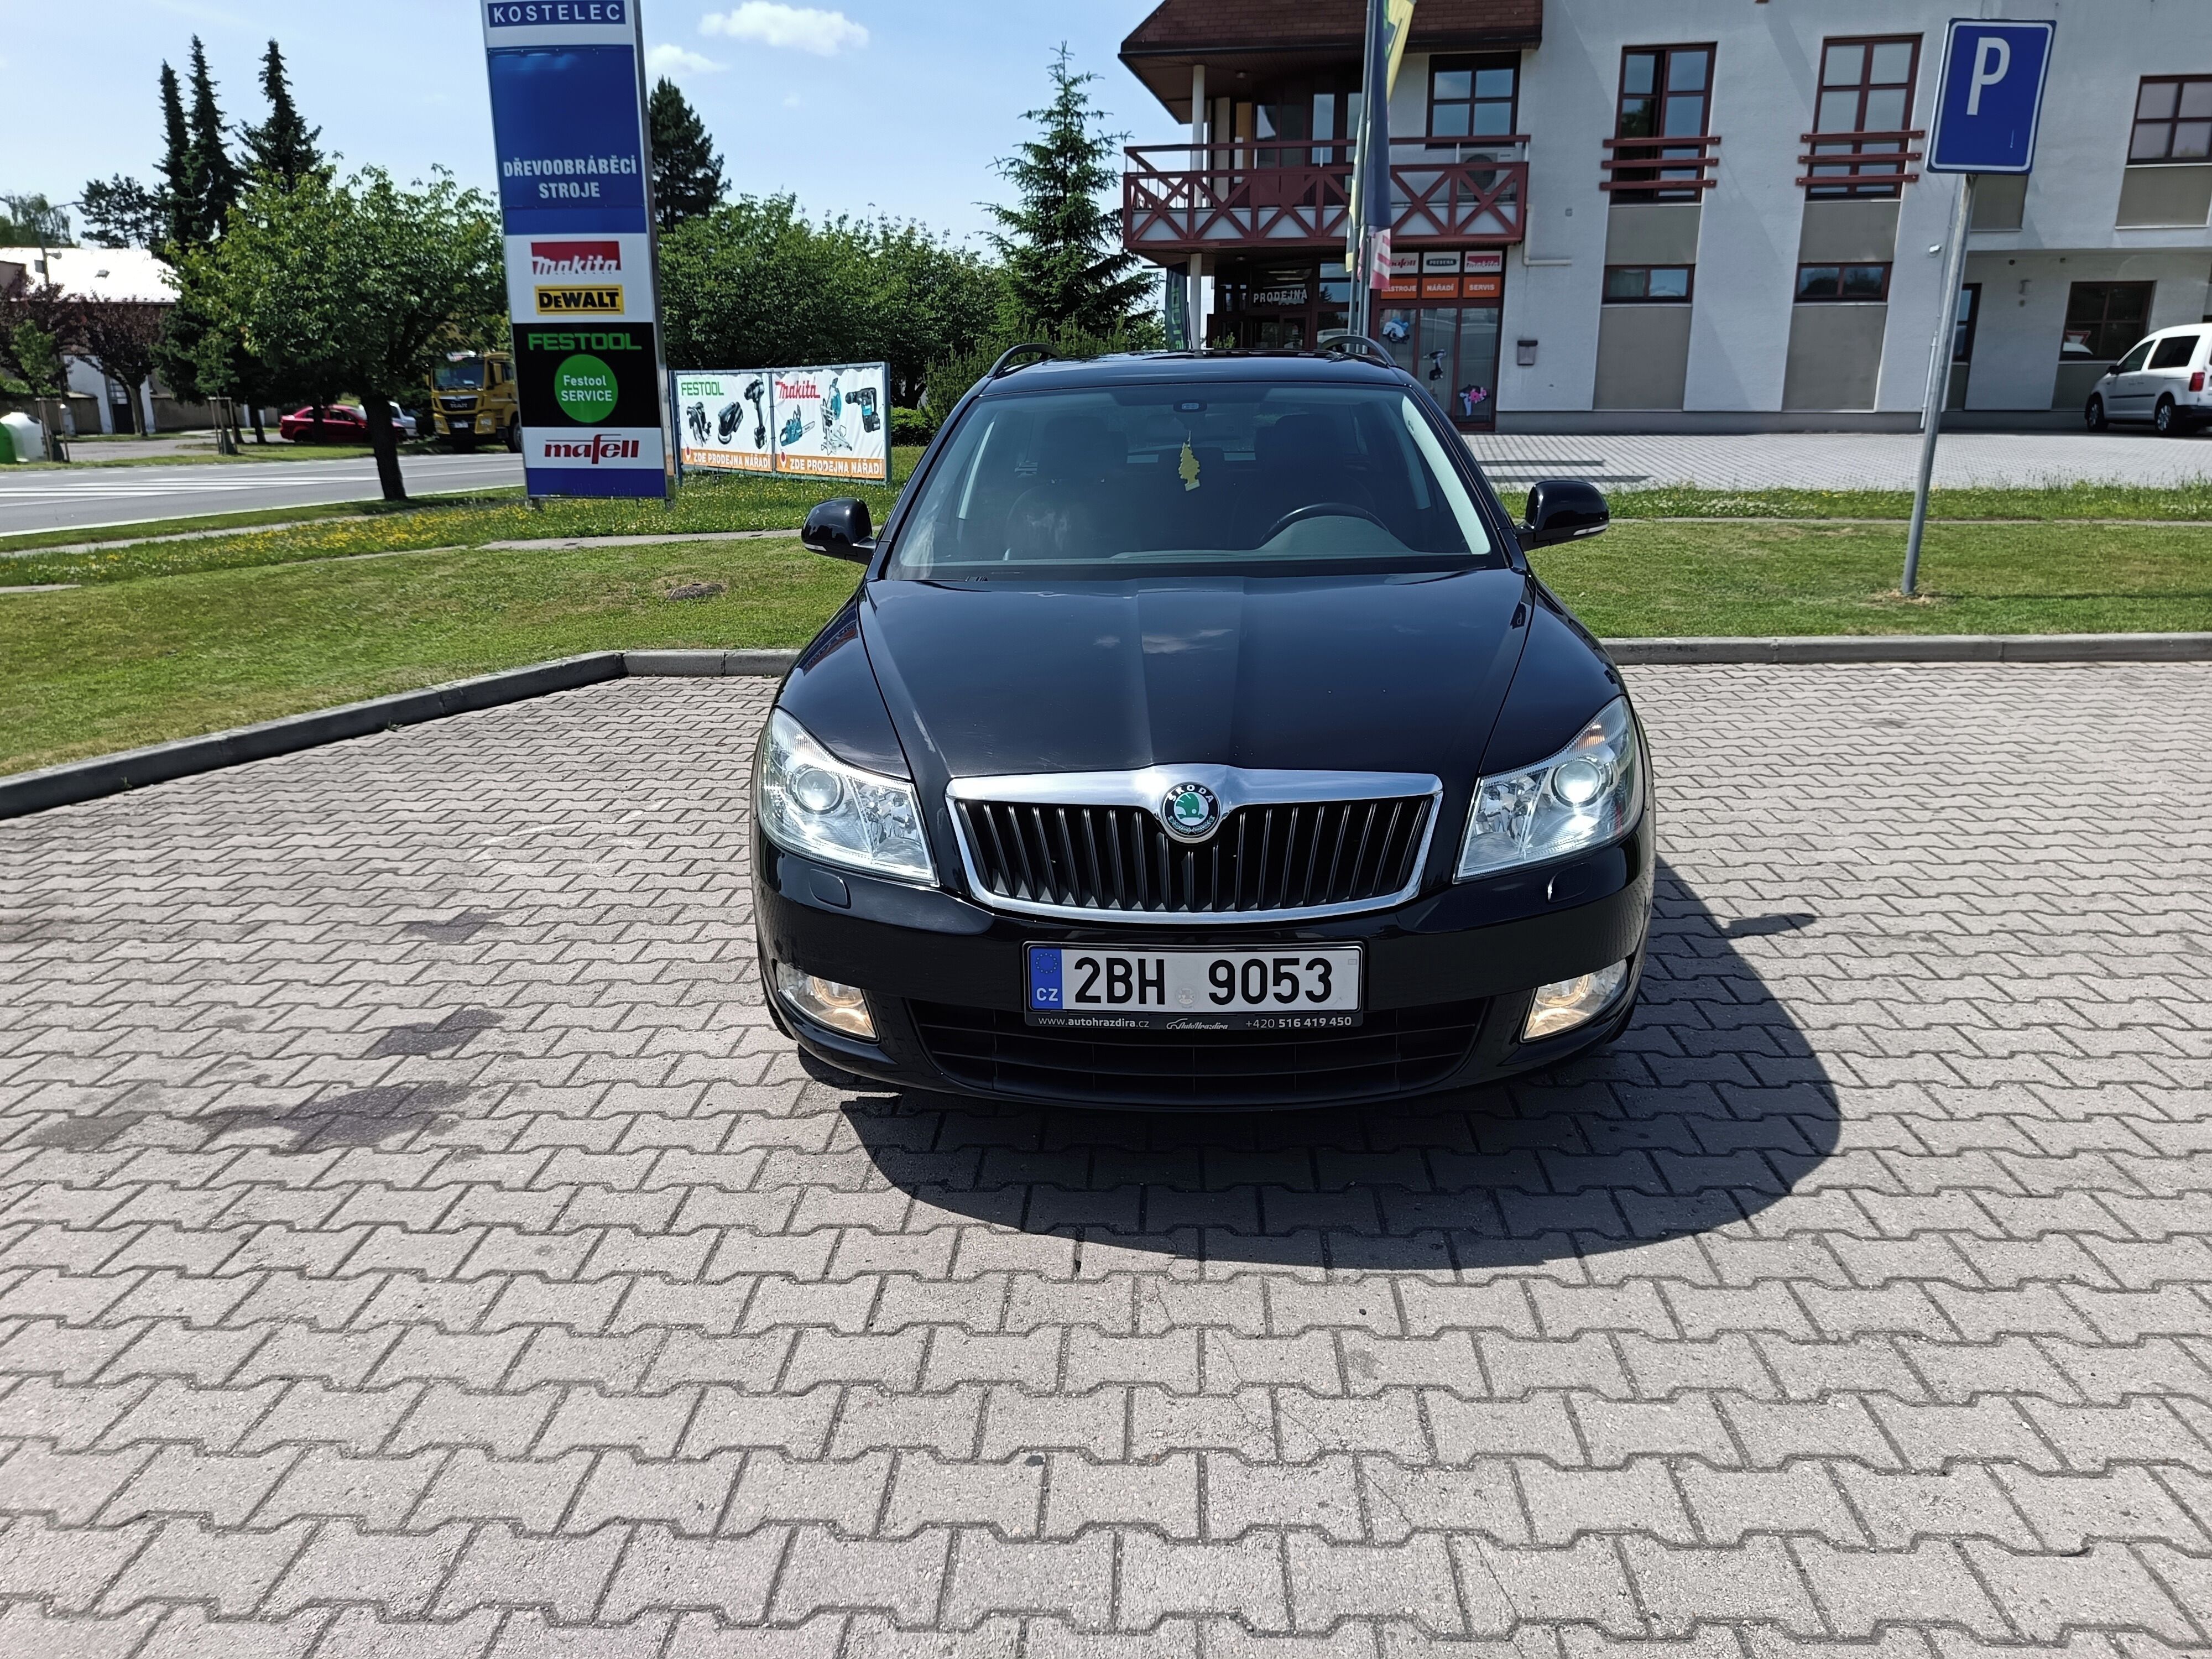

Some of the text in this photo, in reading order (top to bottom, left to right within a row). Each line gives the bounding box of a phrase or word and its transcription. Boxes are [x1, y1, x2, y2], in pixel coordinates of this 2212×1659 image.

[493, 4, 620, 23] KOSTELEC
[1966, 36, 2011, 116] P
[503, 155, 637, 177] DŘEVOOBRÁBĚCÍ
[538, 182, 601, 199] STROJE
[1253, 289, 1307, 303] PRODEJNA
[528, 333, 642, 351] FESTOOL
[563, 375, 606, 387] Festool
[681, 382, 724, 396] FESTOOL
[561, 390, 612, 402] SERVICE
[544, 434, 639, 464] mafell
[693, 452, 770, 469] ZDE PRODEJNA NÁŘADÍ
[790, 458, 883, 475] ZDE PRODEJNA NÁŘADÍ
[1073, 957, 1333, 1005] 2BH 9053
[1036, 988, 1058, 1001] CZ
[1038, 1018, 1149, 1028] www.autohrazdira.cz
[1245, 1016, 1352, 1029] +420 516 419 450
